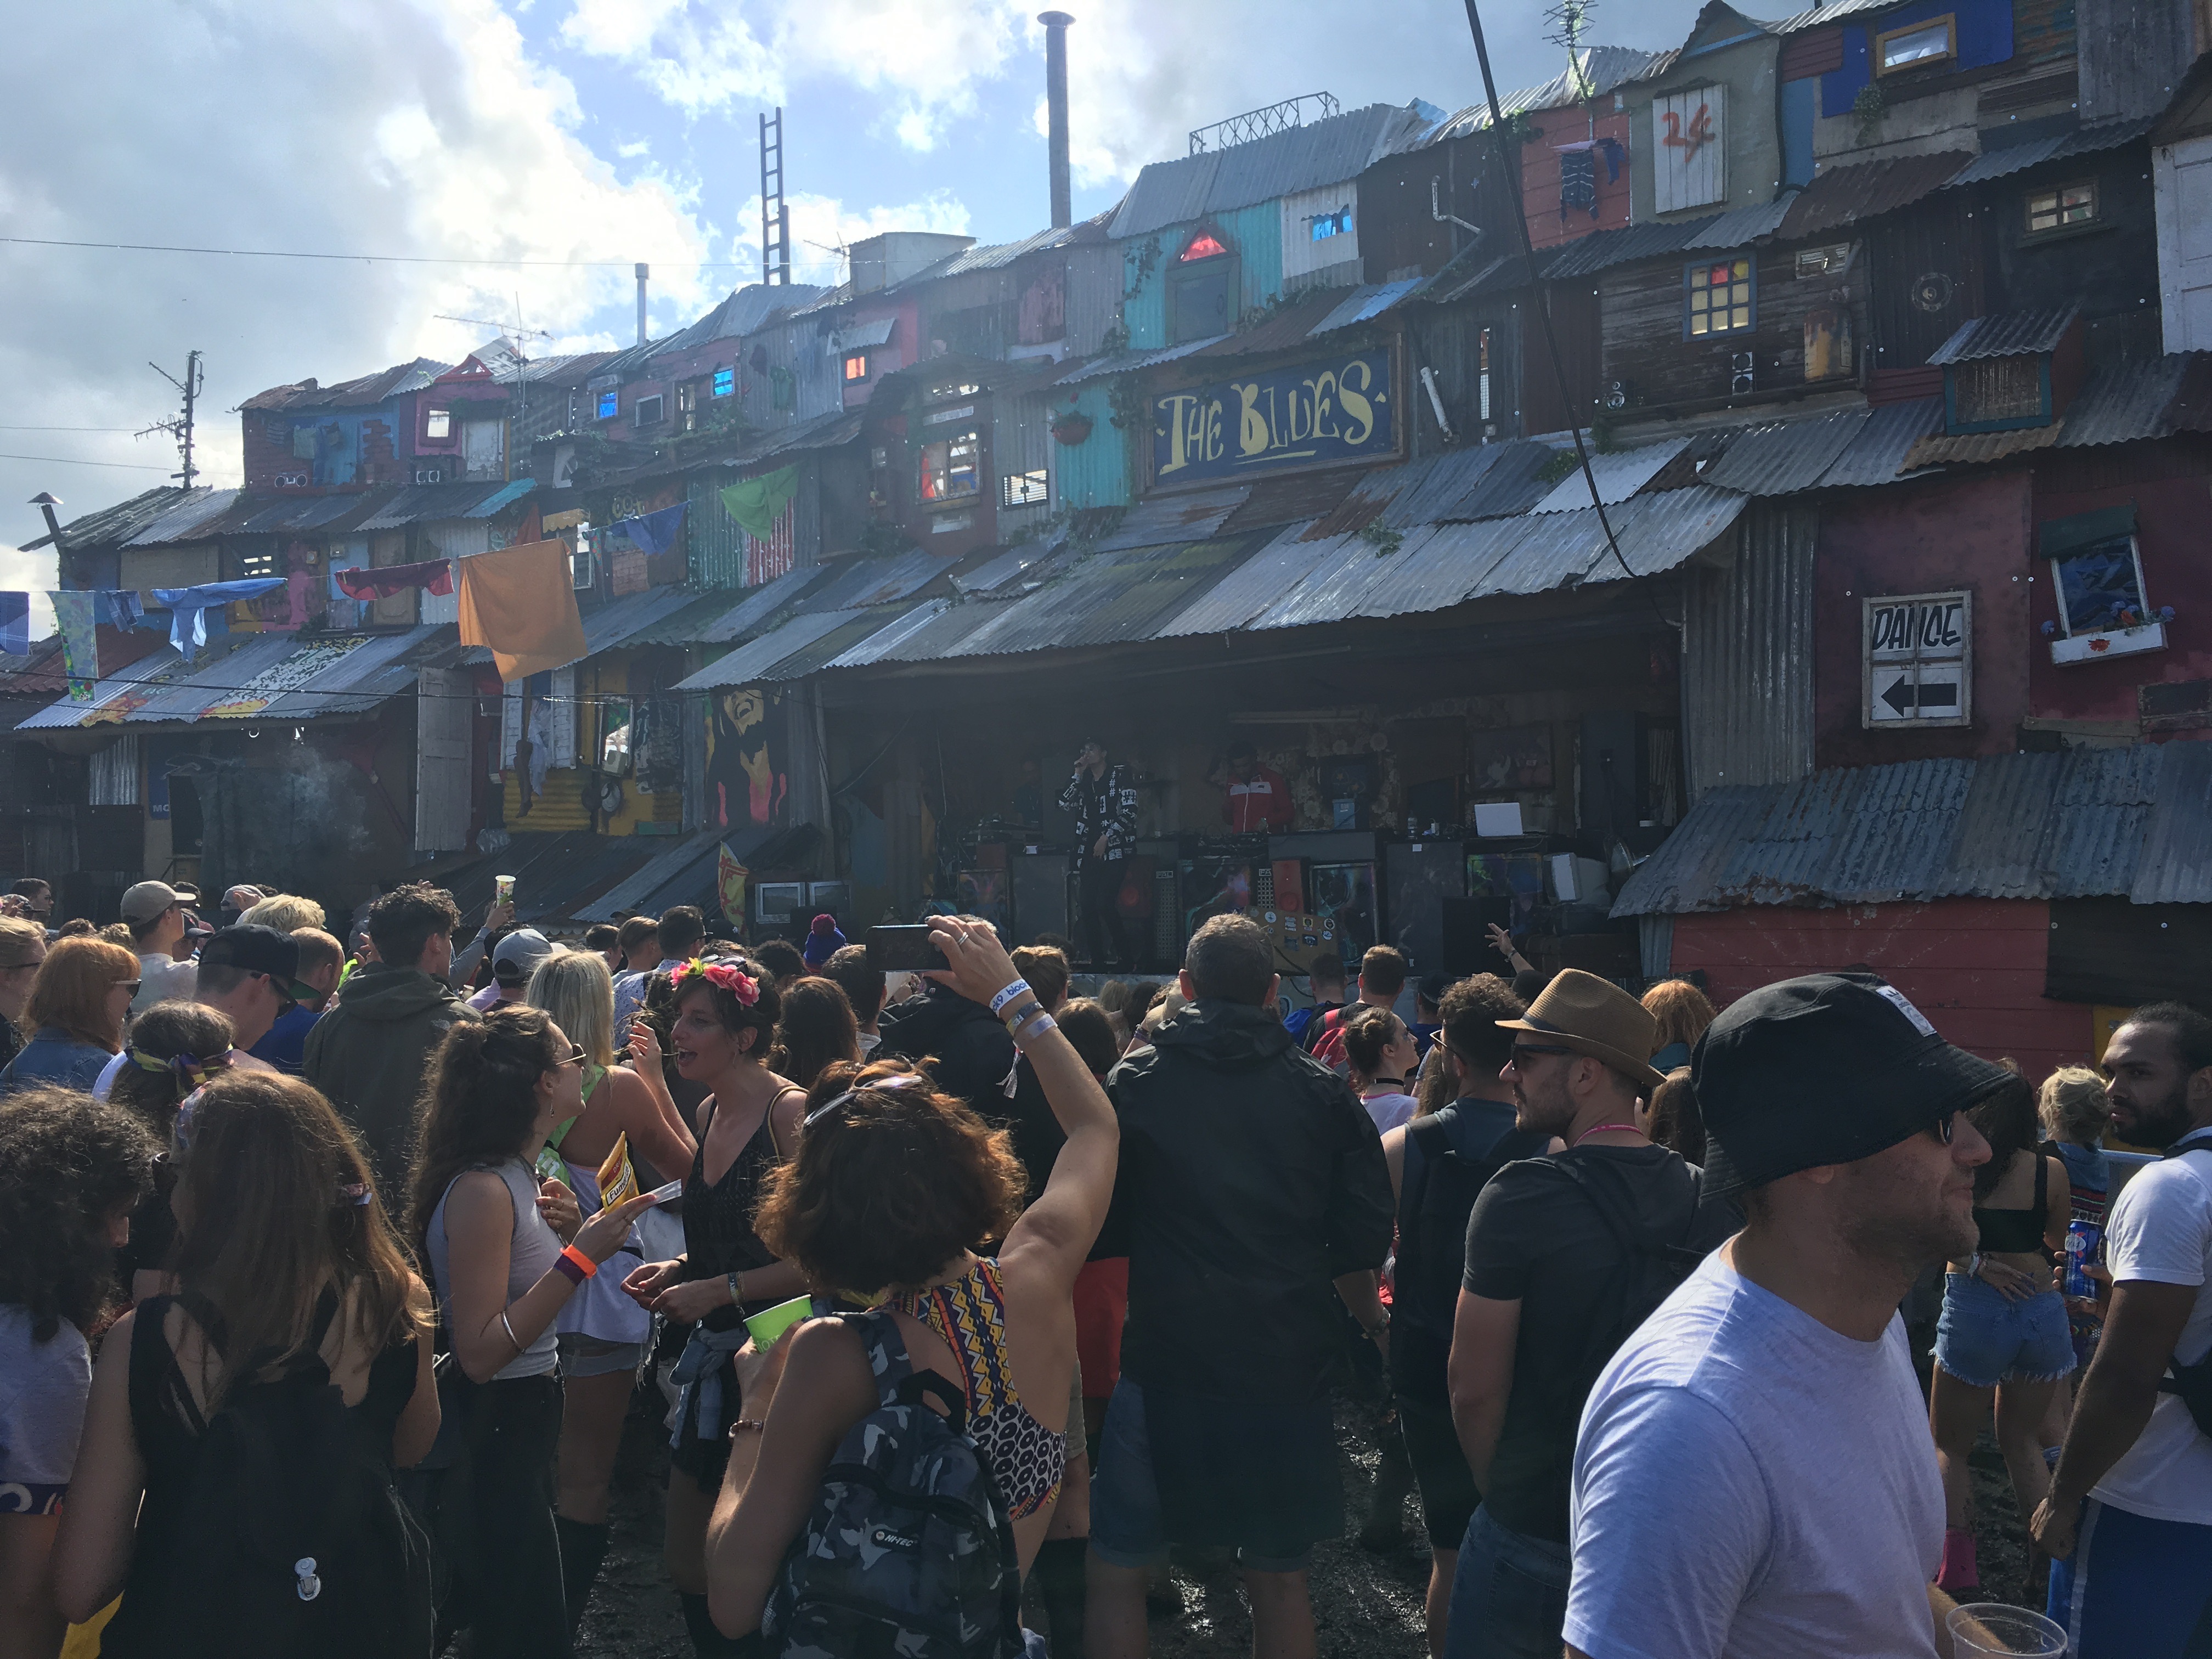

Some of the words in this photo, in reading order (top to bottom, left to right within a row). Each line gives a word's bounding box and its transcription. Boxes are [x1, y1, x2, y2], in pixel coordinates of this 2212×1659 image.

[1661, 103, 1716, 163] 24
[1158, 395, 1224, 476] THE
[1231, 360, 1373, 459] BLUES
[1872, 603, 1963, 650] DANCE
[992, 994, 1003, 1012] ck9
[884, 1534, 914, 1547] HI-TEC
